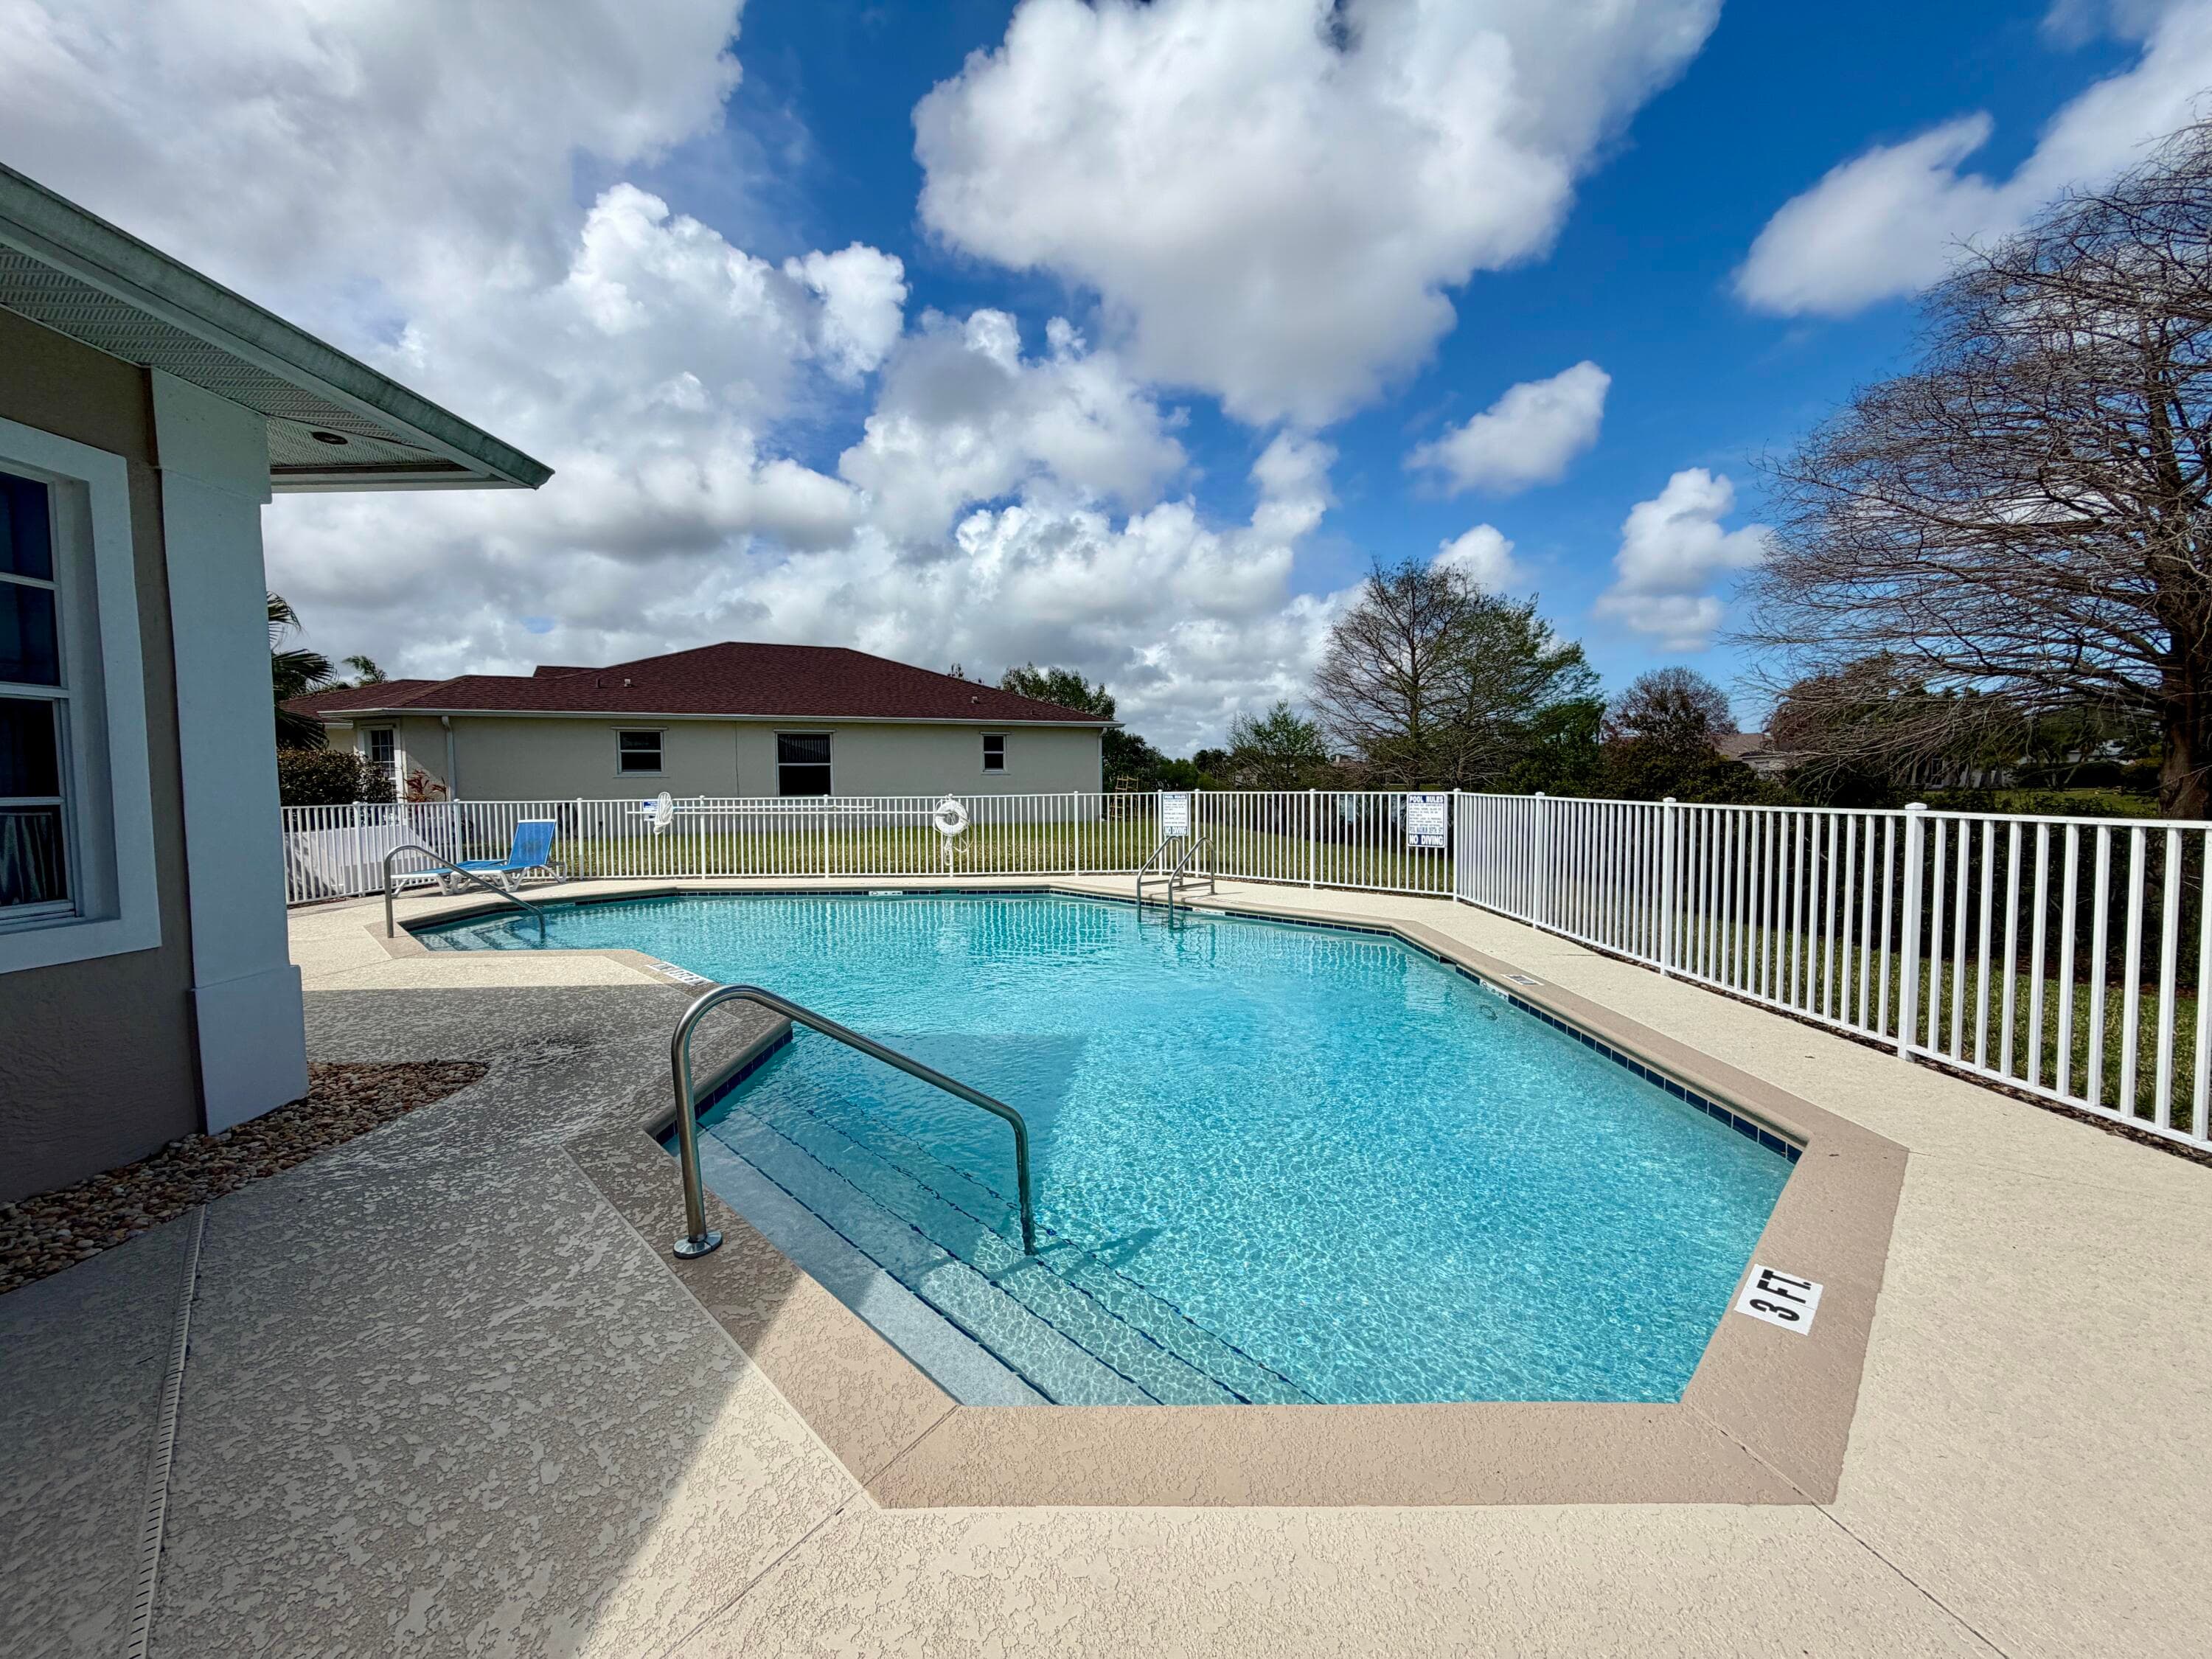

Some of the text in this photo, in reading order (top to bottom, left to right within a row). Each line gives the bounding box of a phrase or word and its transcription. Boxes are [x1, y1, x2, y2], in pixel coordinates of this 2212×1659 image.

[1172, 827, 1187, 835] DIVING
[1409, 835, 1443, 845] NO DIVING
[1750, 1299, 1800, 1321] 3
